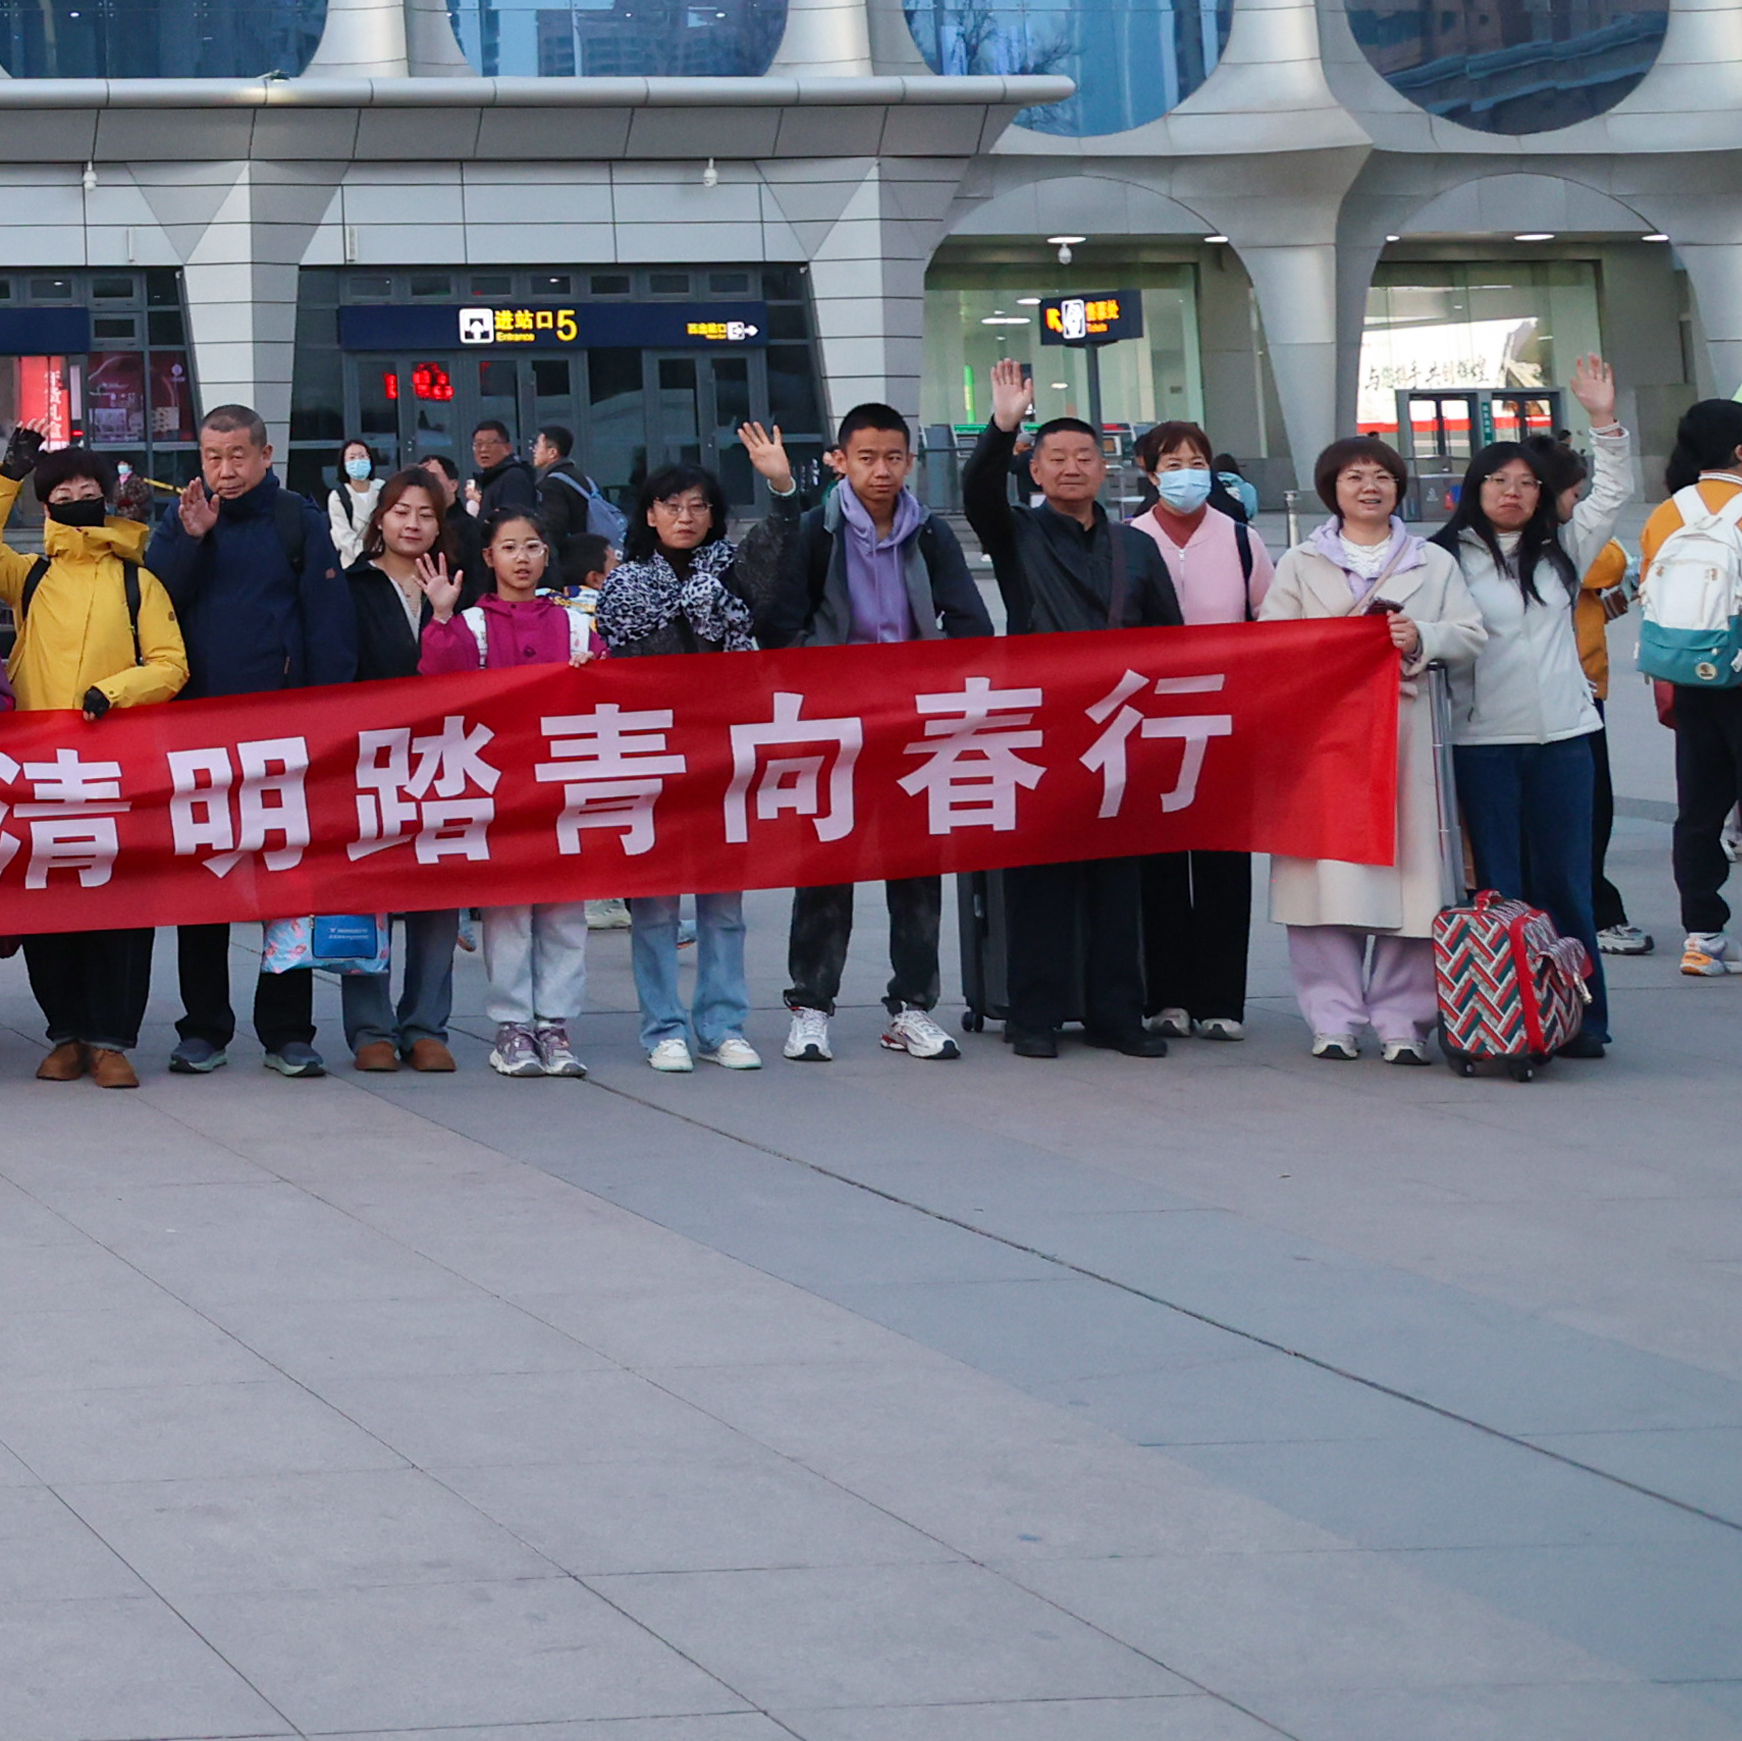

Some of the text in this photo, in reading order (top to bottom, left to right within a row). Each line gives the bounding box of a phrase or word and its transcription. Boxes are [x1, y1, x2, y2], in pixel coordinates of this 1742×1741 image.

[494, 309, 578, 341] 进站口 5
[496, 332, 536, 343] Entrance
